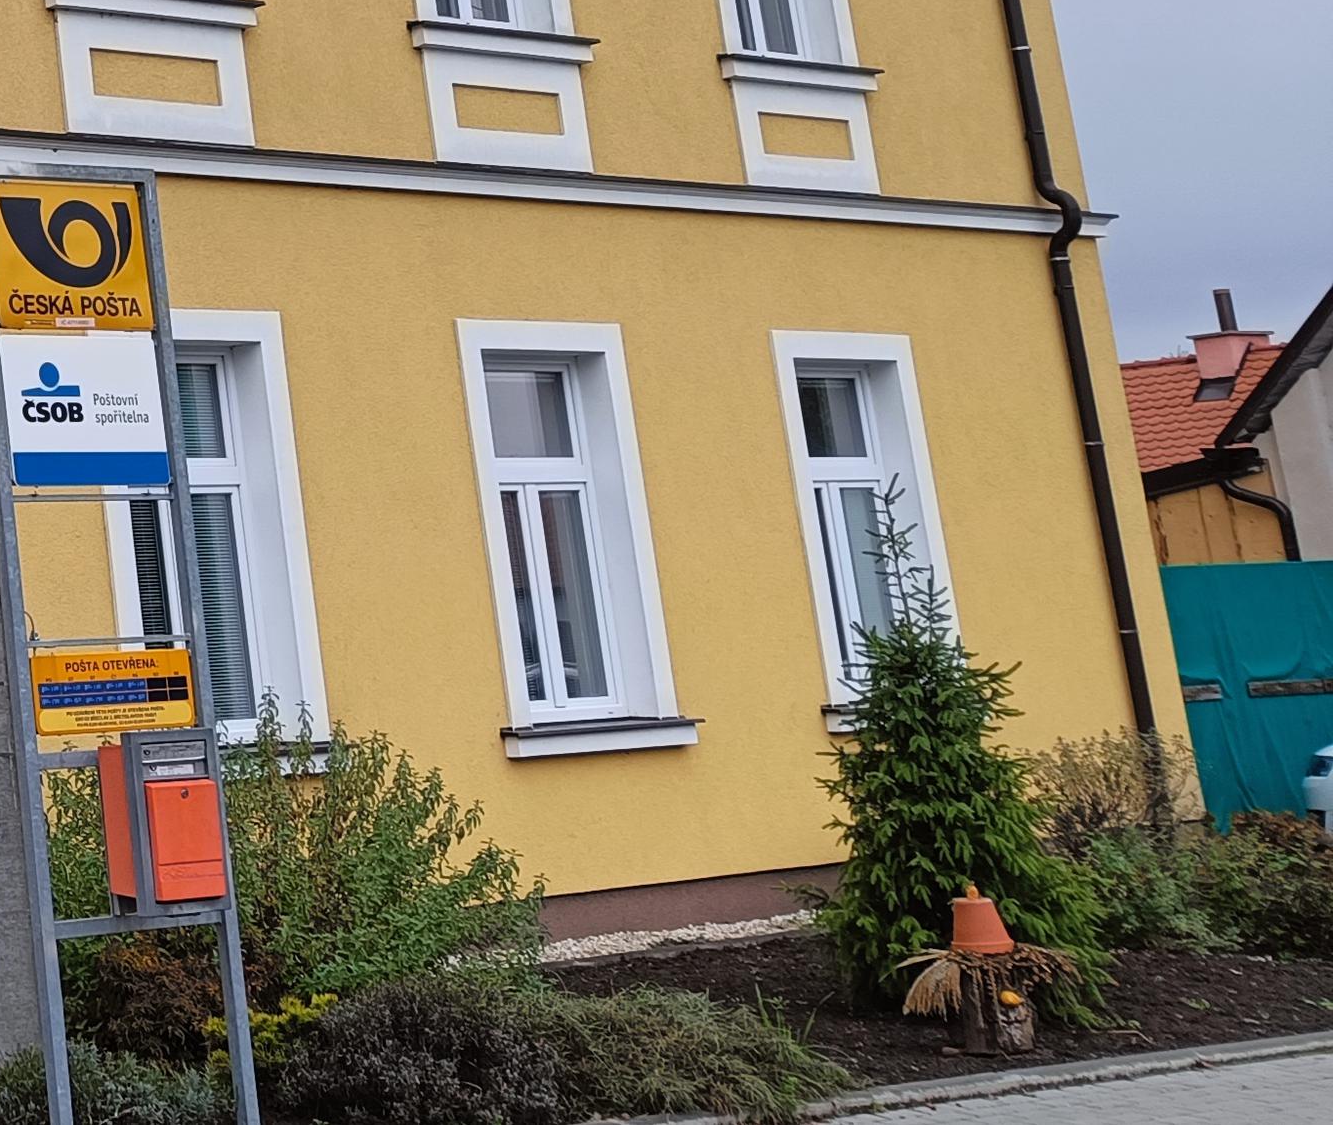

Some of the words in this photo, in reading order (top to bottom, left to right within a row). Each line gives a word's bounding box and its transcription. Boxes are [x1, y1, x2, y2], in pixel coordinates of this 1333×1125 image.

[8, 288, 74, 316] ČESKÁ
[80, 291, 142, 317] POŠTA
[93, 393, 139, 406] Poštovní
[22, 399, 84, 423] ČSOB
[95, 409, 150, 426] spořitelna
[64, 659, 100, 673] POŠTA
